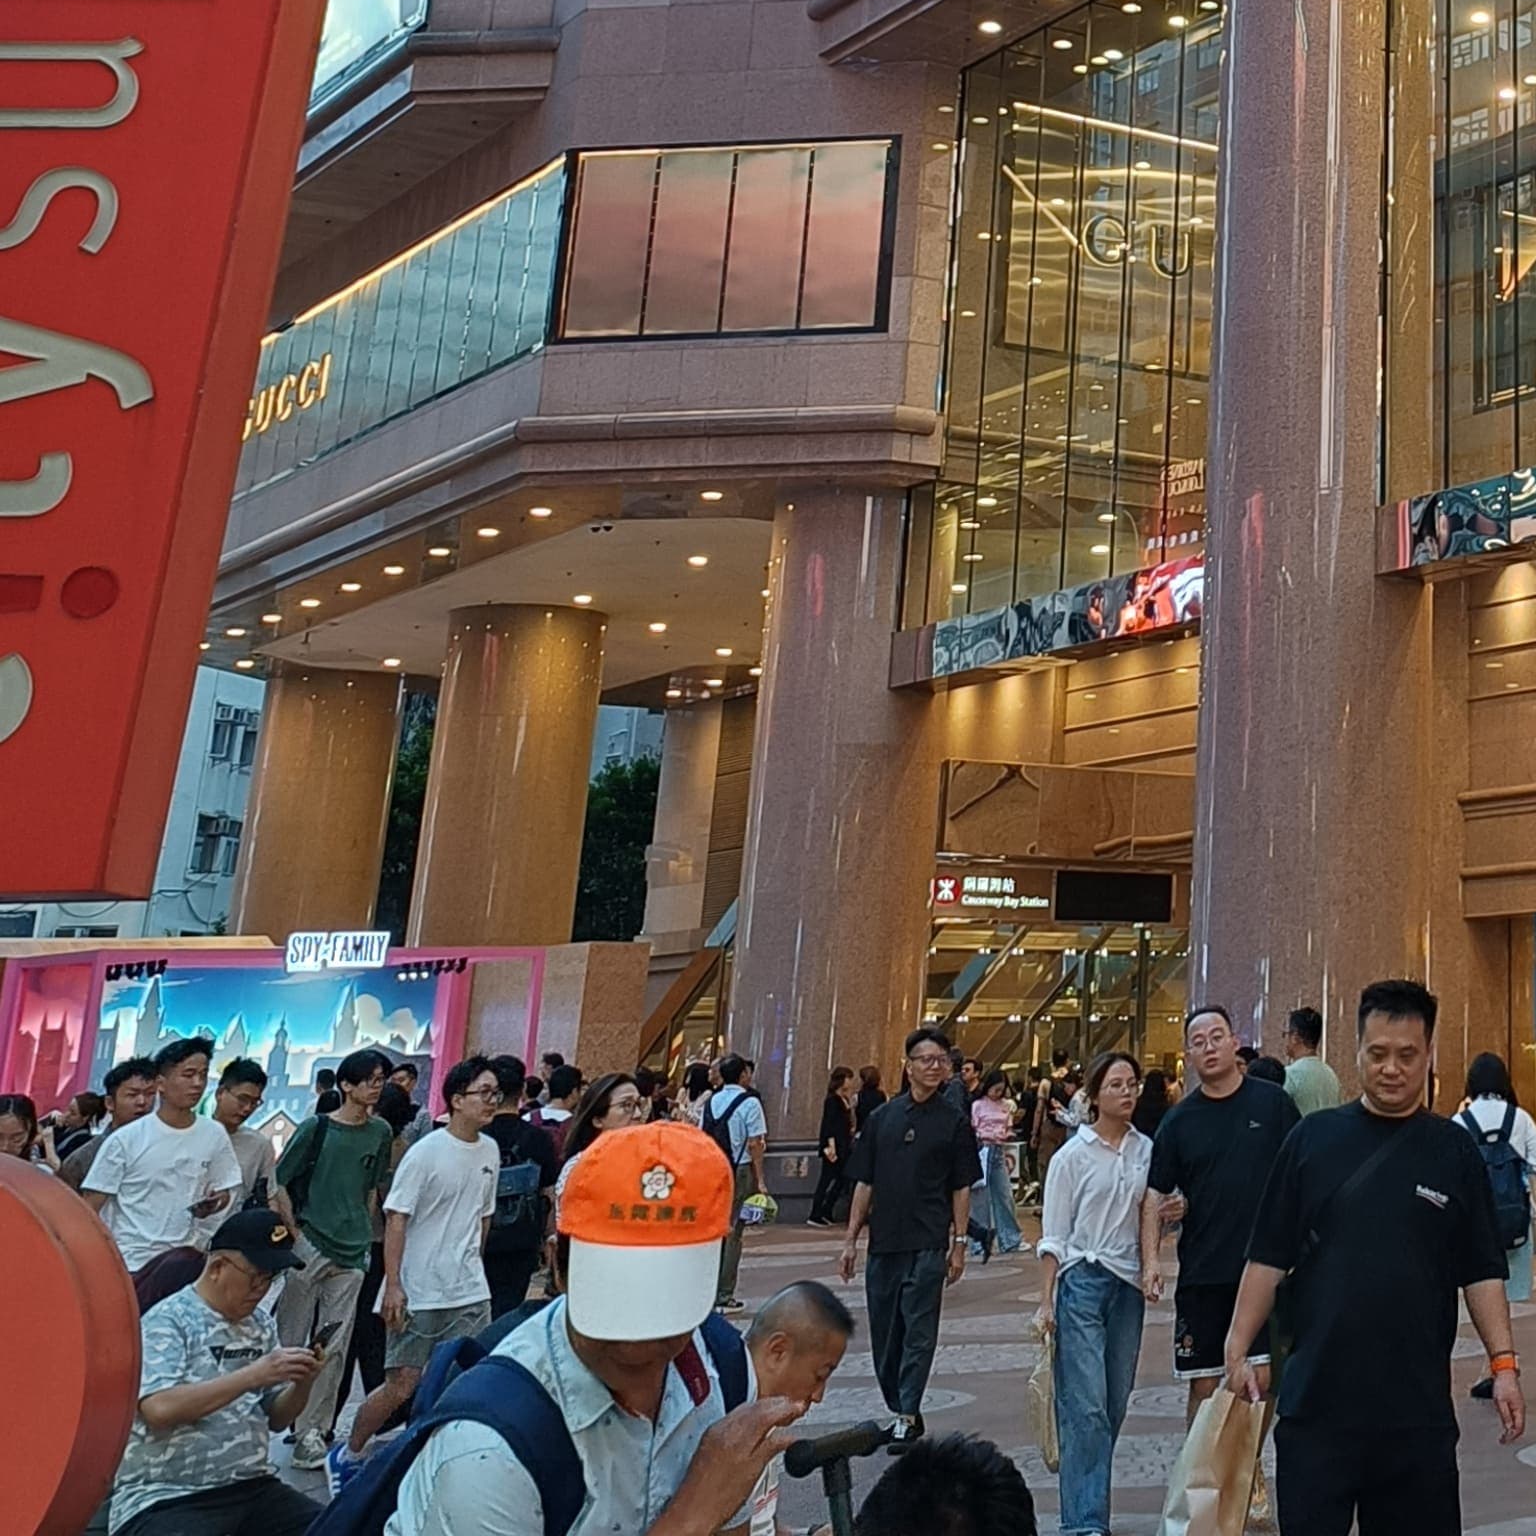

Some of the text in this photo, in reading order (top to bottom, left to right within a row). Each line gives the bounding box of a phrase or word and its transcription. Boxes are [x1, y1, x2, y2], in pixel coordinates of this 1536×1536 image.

[961, 895, 1049, 909] Causeway Bay Station
[331, 935, 387, 962] FAMILY
